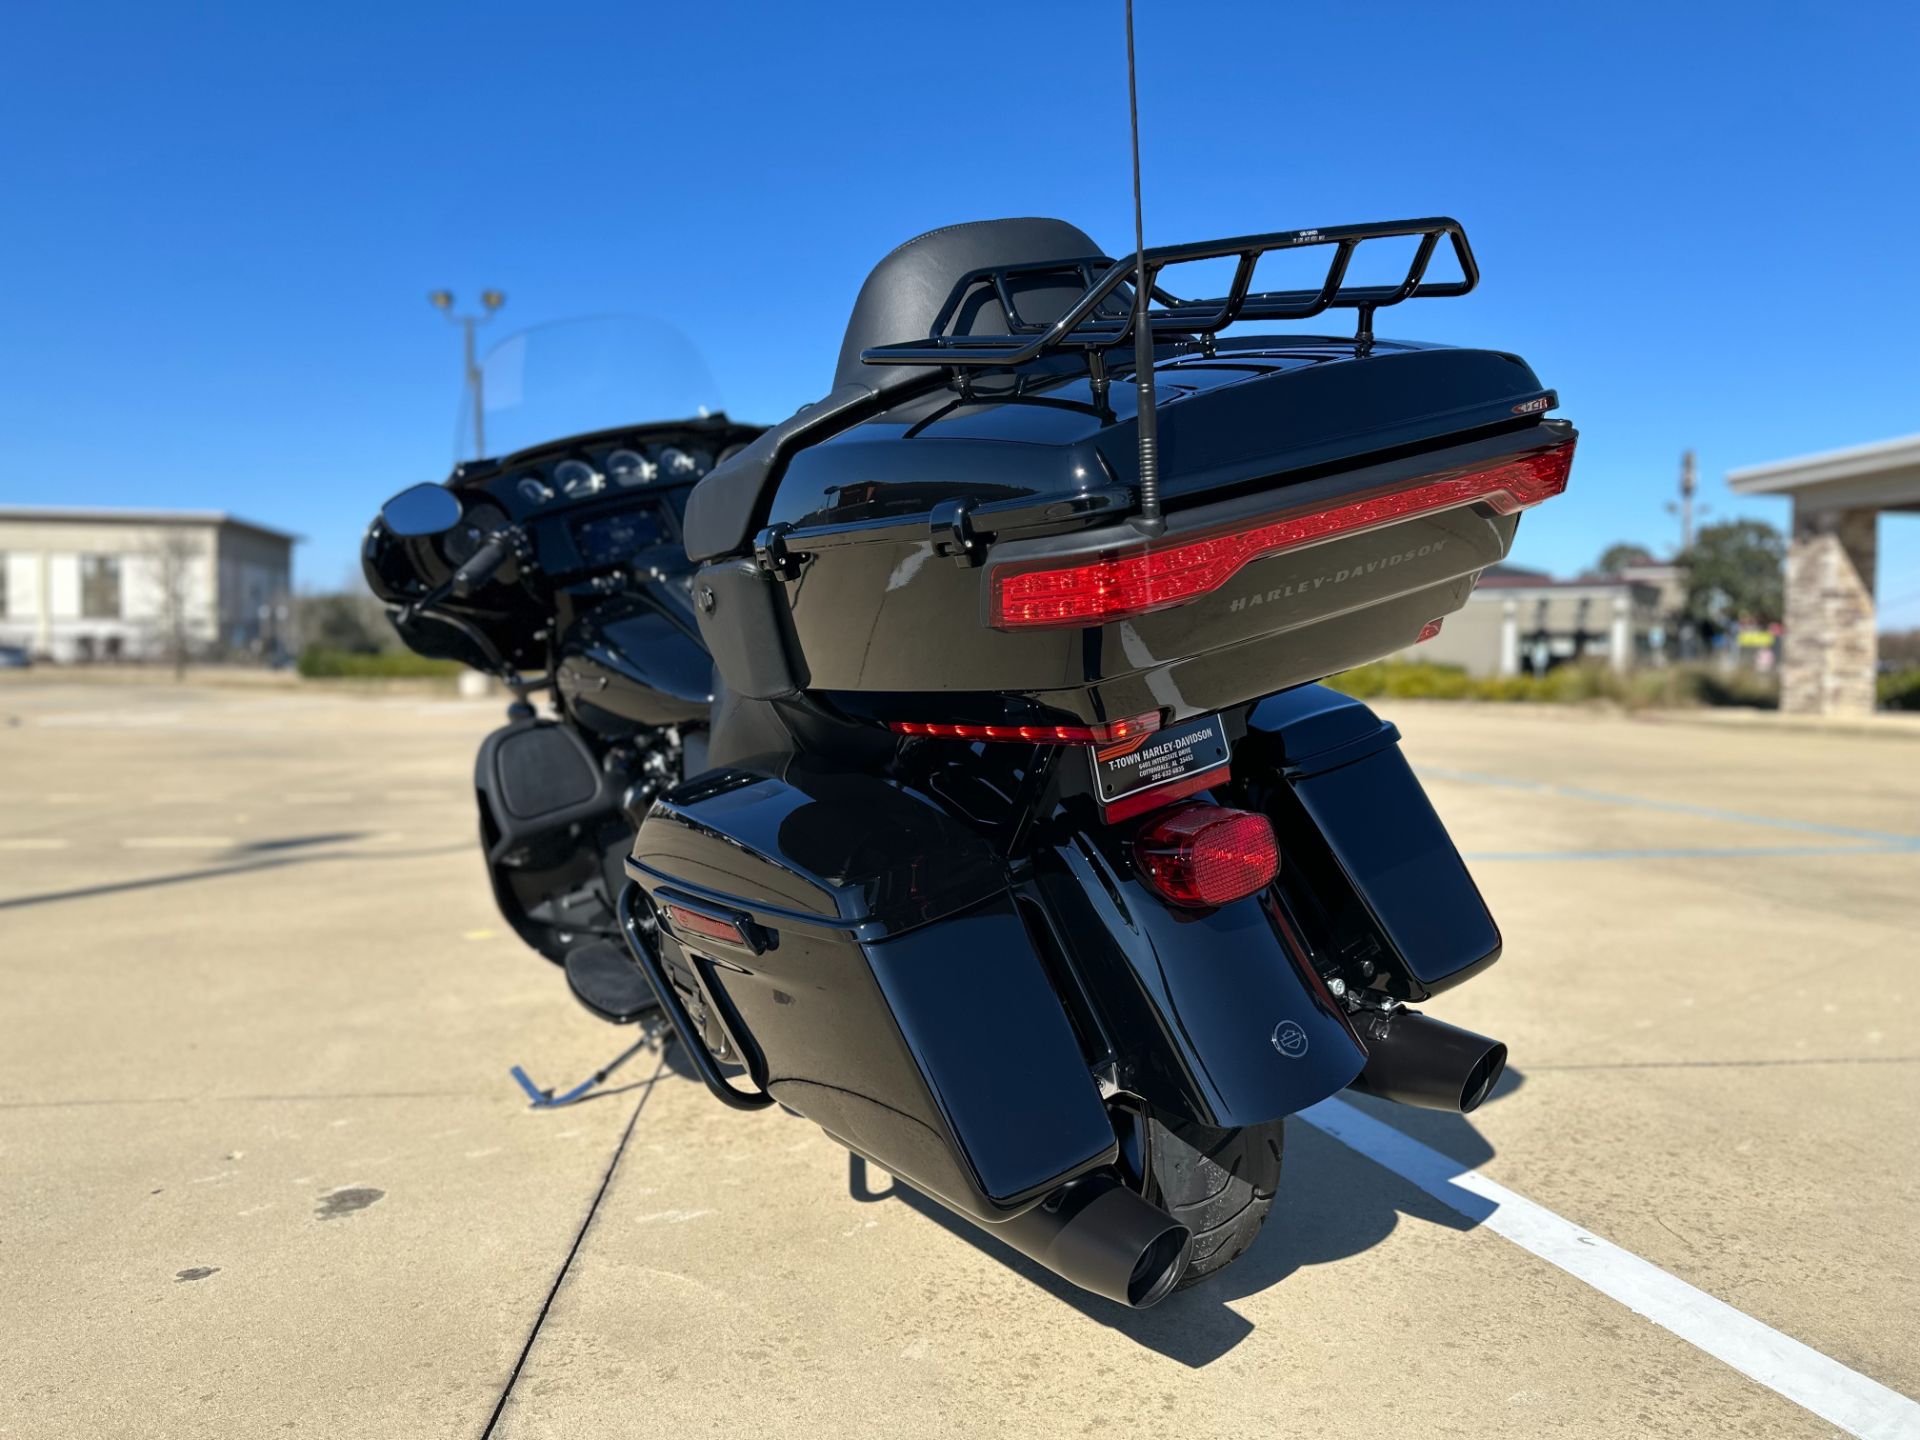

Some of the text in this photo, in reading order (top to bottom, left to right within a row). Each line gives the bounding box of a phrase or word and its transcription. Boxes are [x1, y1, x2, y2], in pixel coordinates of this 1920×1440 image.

[1229, 539, 1448, 613] HARLEY-DAVIDSON
[1108, 728, 1213, 771] T-TOWN HARLEY-DAVIDSON
[1139, 747, 1191, 770] 6401 INTERSTATE DRIVE
